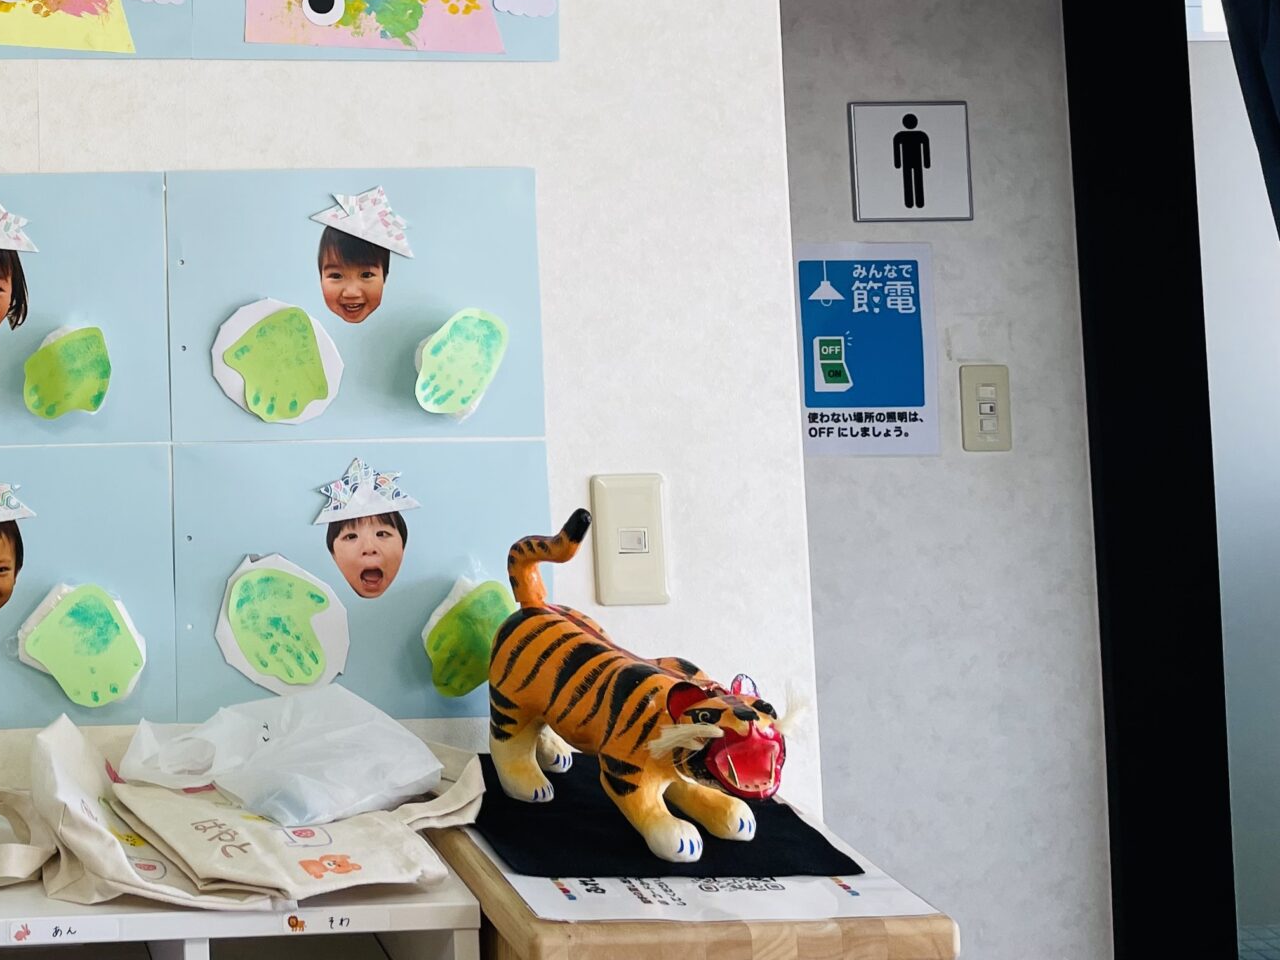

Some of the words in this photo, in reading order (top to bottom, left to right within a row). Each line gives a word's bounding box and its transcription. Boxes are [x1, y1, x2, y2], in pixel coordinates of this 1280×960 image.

[852, 264, 912, 278] みんなで
[851, 281, 916, 313] 節電
[821, 346, 841, 354] OFF
[828, 370, 841, 378] ON
[807, 411, 925, 424] 使わない場所の照明は、
[190, 819, 252, 858] はやと
[52, 925, 77, 938] あん
